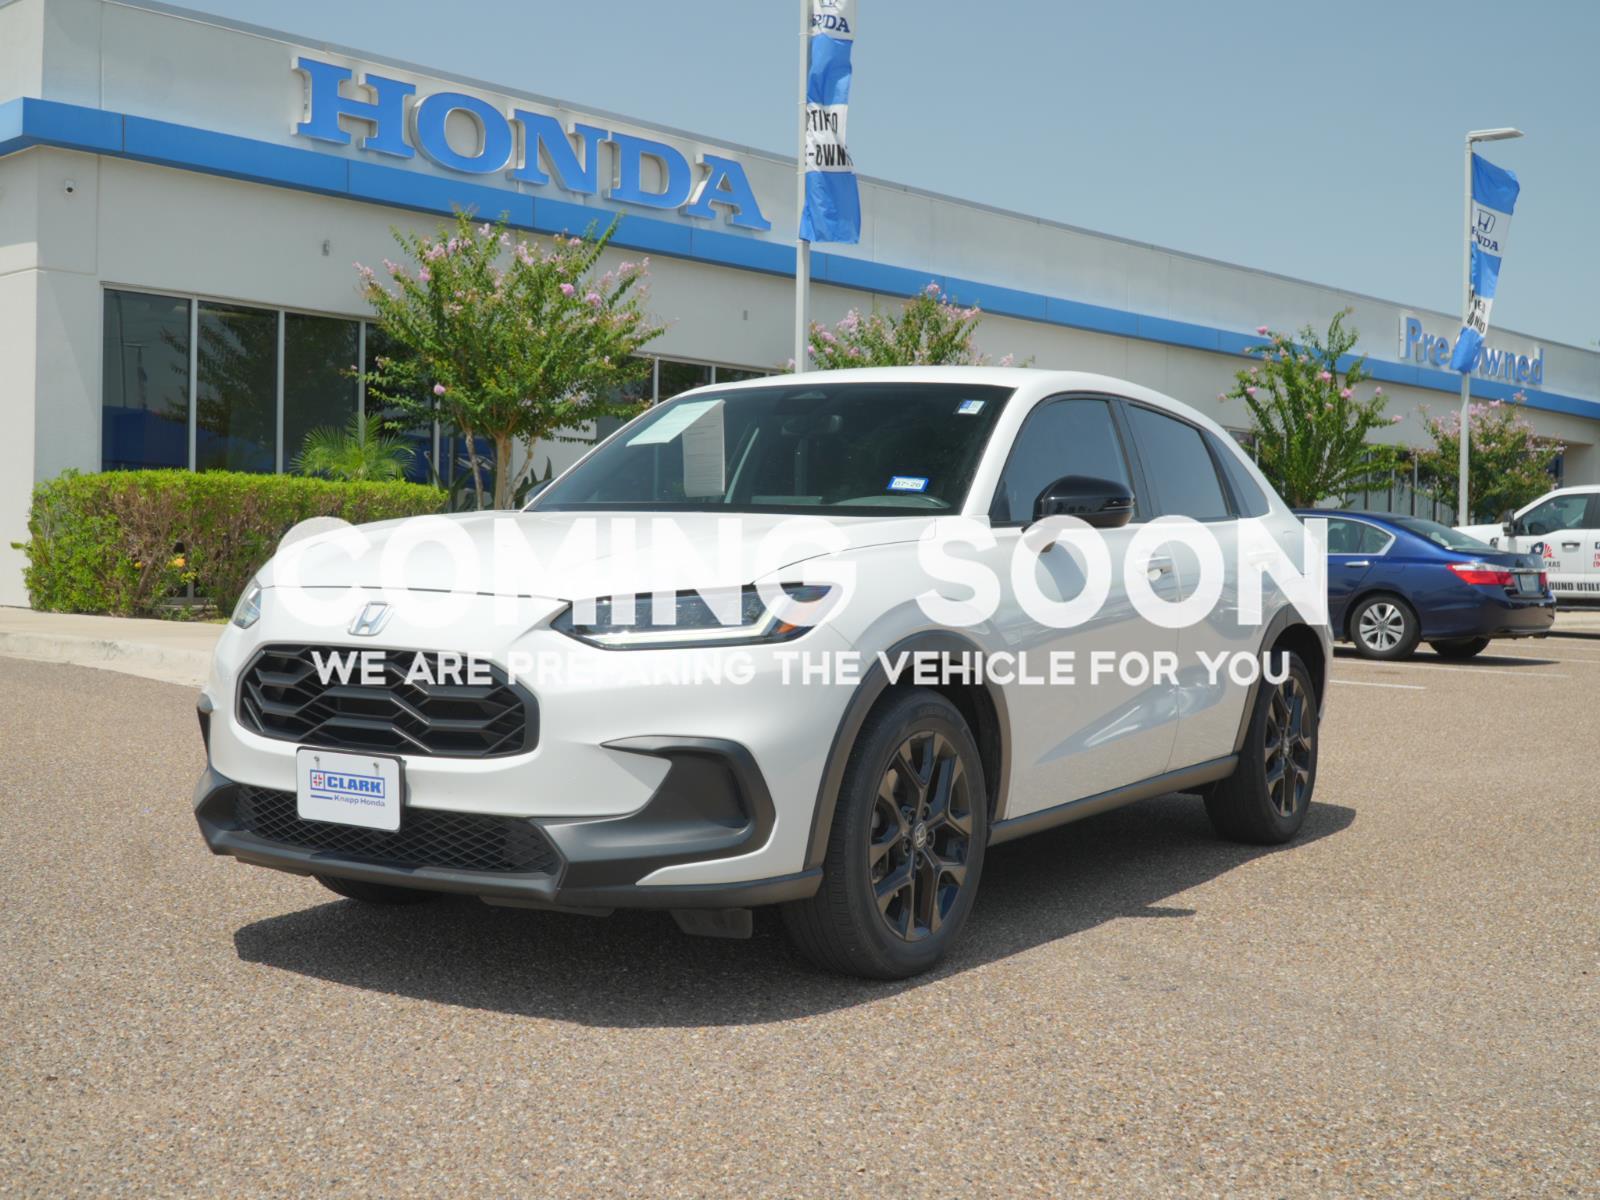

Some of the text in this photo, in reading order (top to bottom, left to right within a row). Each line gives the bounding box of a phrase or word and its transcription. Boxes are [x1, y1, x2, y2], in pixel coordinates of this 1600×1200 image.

[292, 56, 772, 231] HONDA
[1472, 345, 1545, 386] wned
[327, 776, 381, 793] CLARK
[334, 795, 385, 807] Knapp Honda
